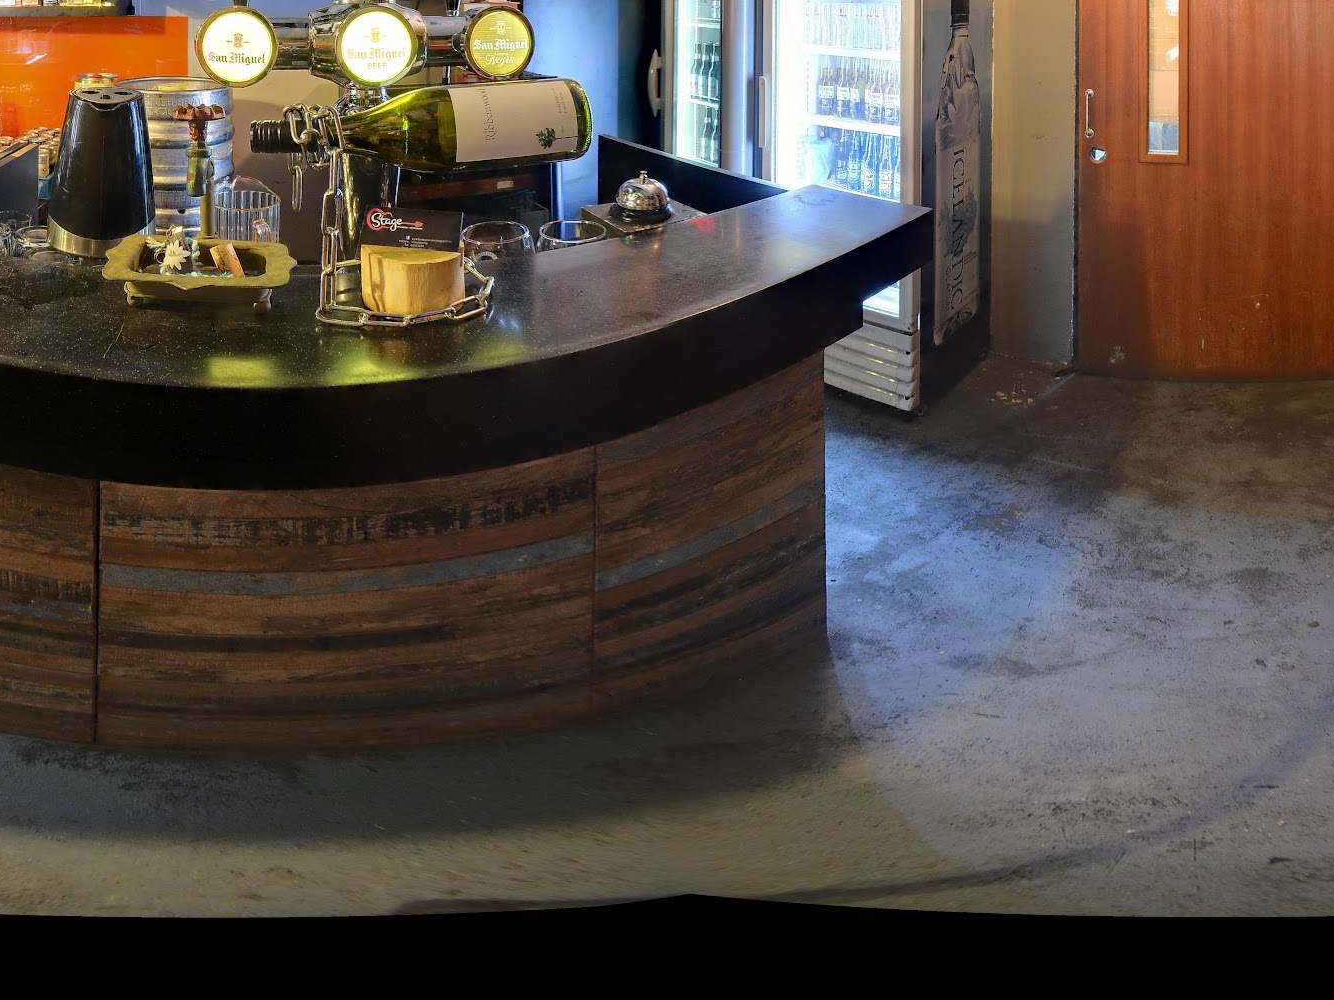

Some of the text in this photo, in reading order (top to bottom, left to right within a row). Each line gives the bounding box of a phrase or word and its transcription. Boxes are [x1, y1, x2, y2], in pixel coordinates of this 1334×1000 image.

[473, 38, 528, 52] San Miguel
[208, 51, 266, 66] San Miguel
[347, 47, 406, 60] San Miguel
[485, 54, 517, 67] Negra
[367, 62, 388, 70] BEER
[477, 88, 497, 141] Ribbonwood
[371, 212, 403, 231] Stage
